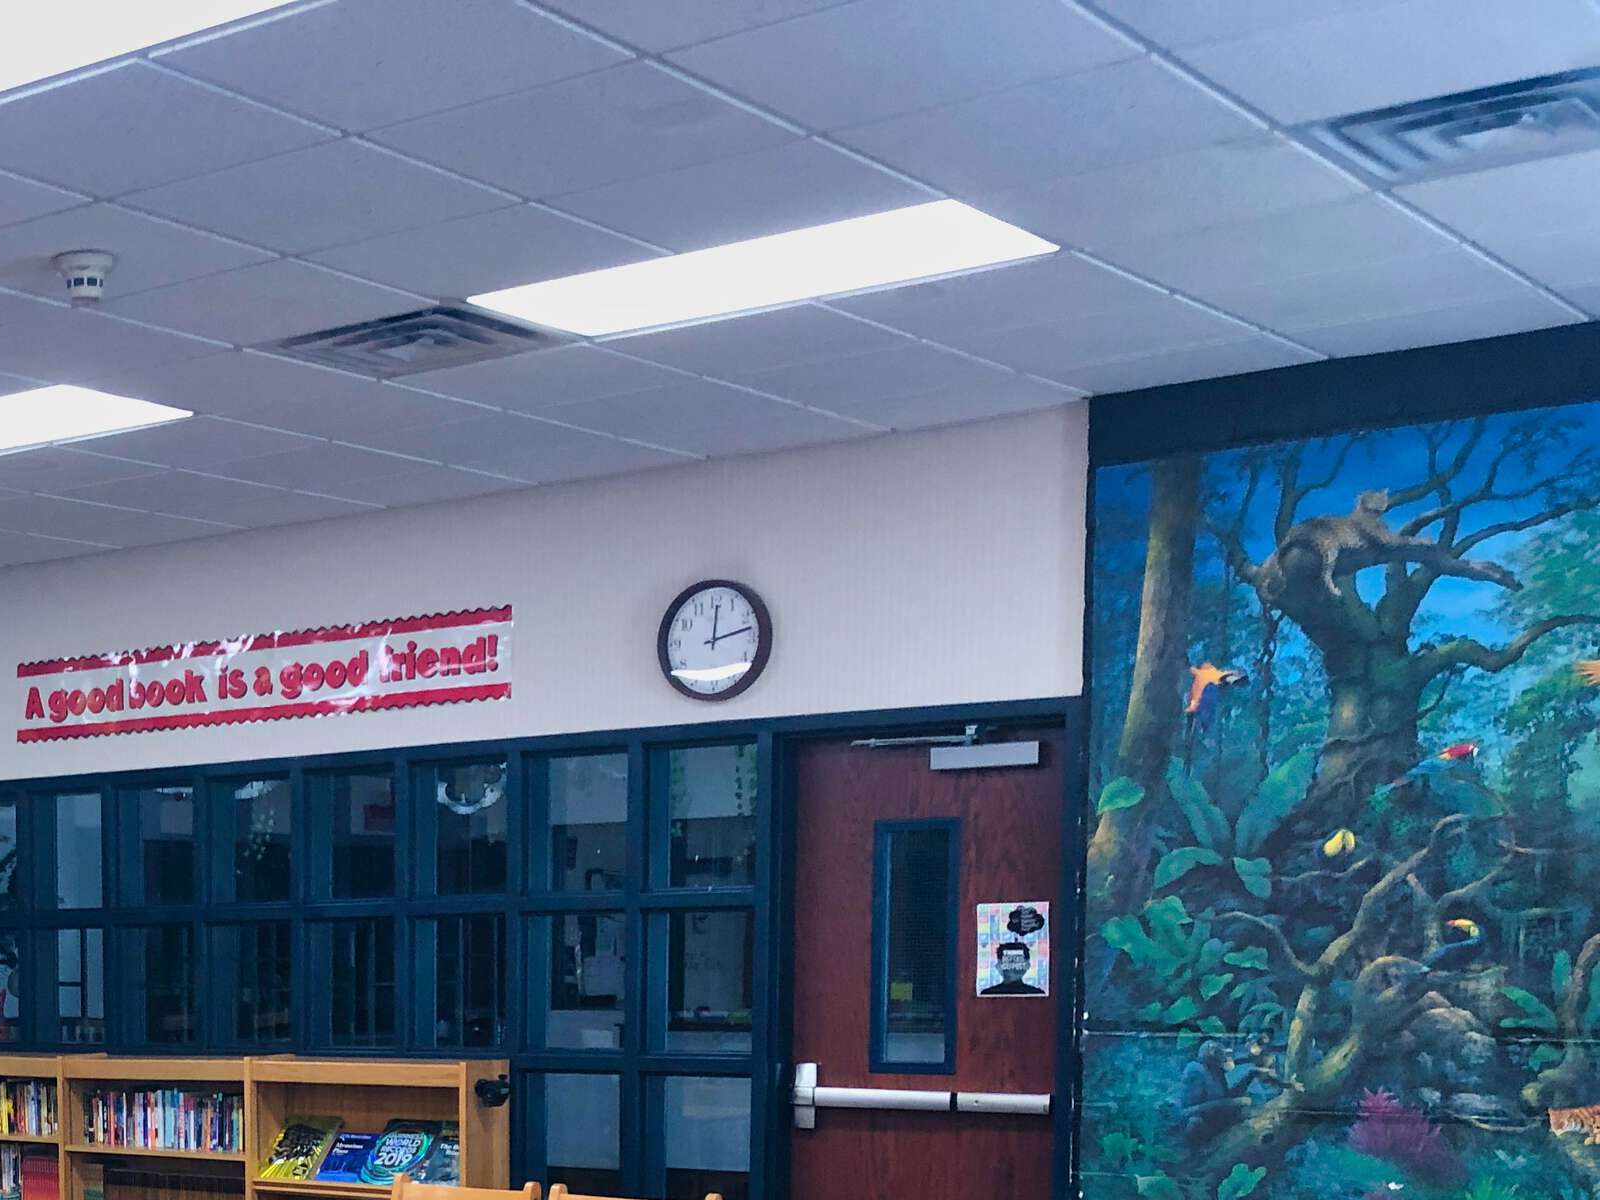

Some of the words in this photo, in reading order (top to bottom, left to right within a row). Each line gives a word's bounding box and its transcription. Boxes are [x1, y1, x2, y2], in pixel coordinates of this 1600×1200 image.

[25, 686, 45, 720] A
[48, 678, 124, 723] good
[128, 669, 208, 709] book
[218, 664, 248, 699] is
[253, 666, 273, 696] a
[280, 650, 369, 699] good
[374, 1153, 412, 1166] 2019
